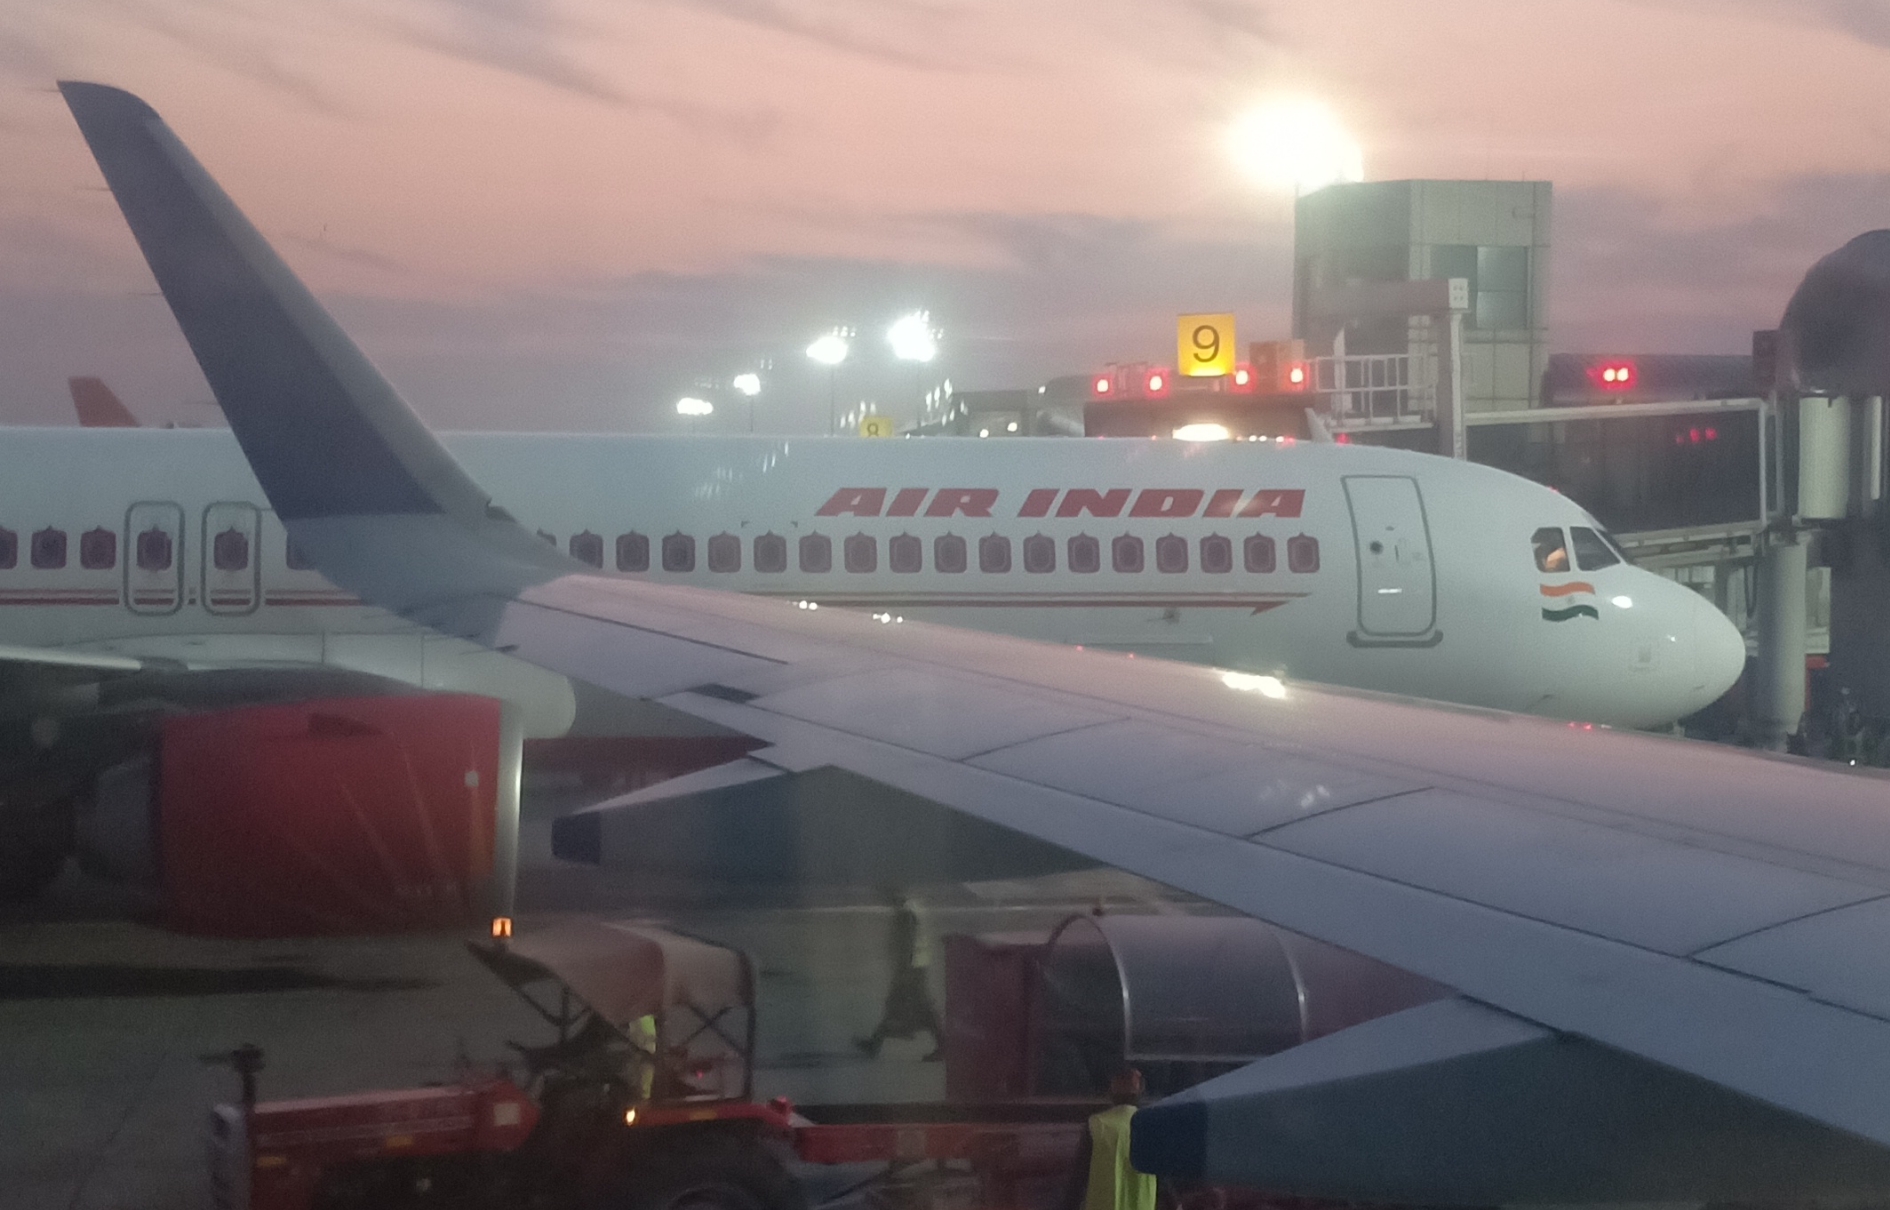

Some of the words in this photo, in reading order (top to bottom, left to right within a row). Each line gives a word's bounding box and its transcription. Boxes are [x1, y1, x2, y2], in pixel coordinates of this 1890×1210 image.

[1192, 324, 1220, 363] 9
[814, 487, 999, 518] AIR
[1016, 488, 1306, 518] INDIA
